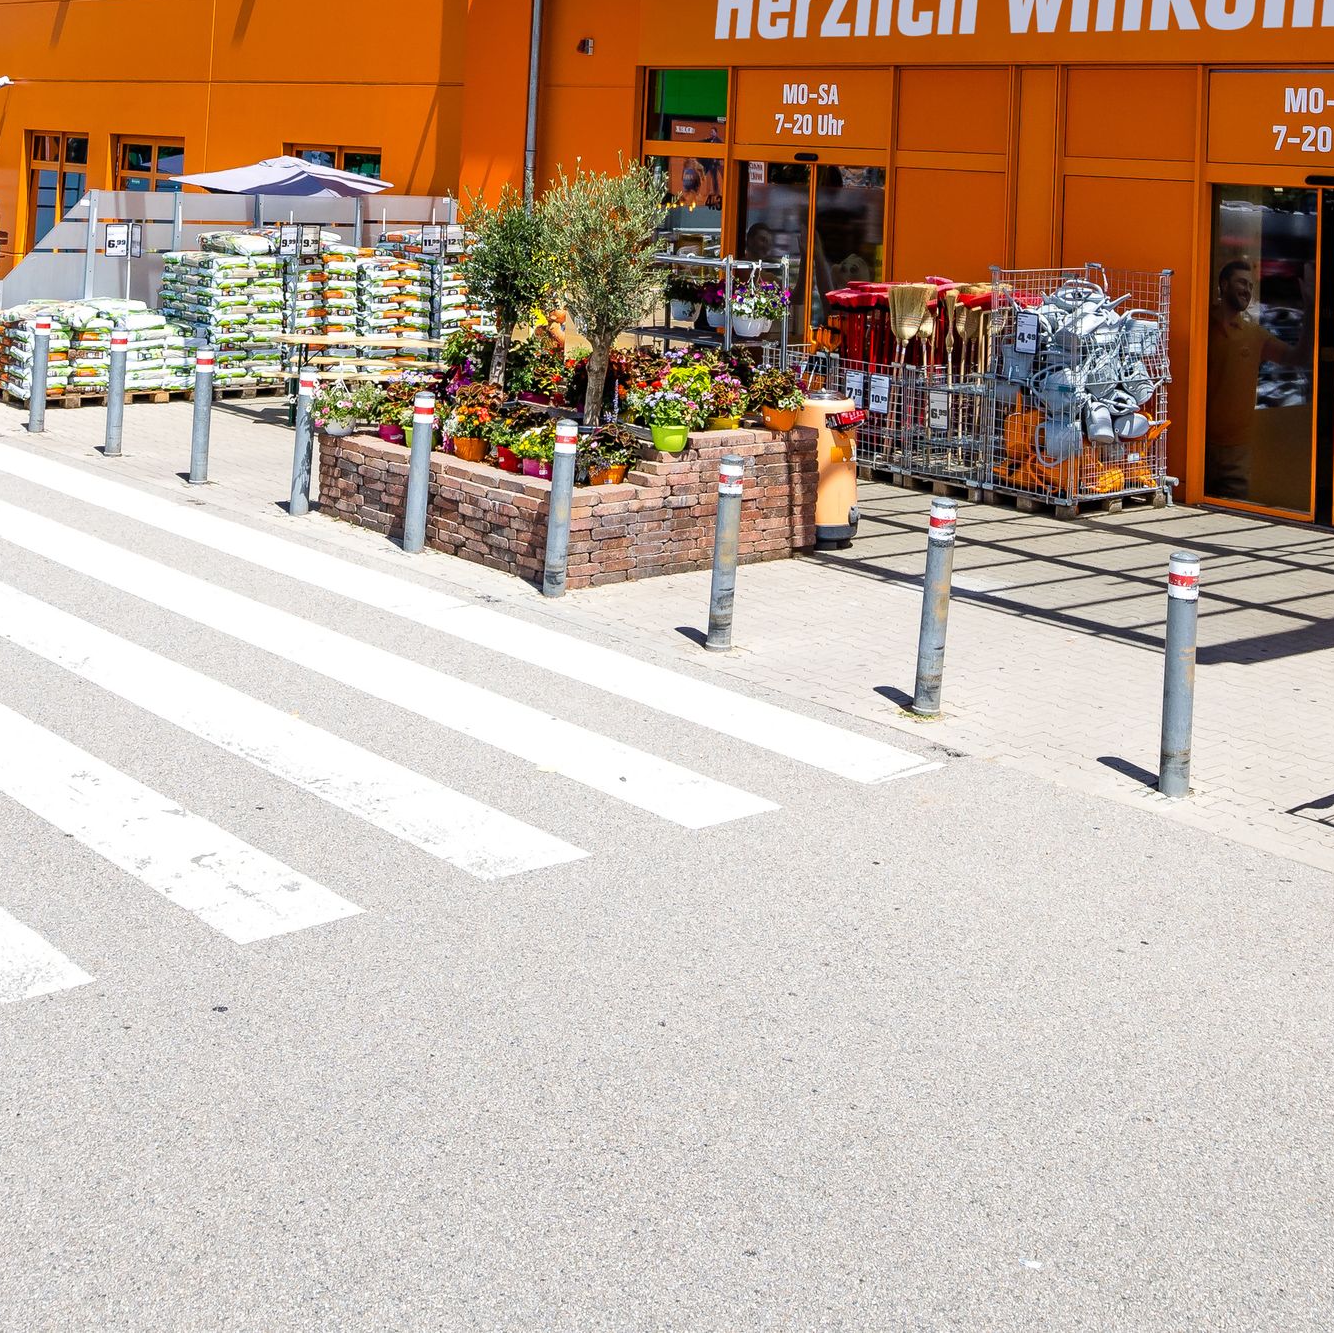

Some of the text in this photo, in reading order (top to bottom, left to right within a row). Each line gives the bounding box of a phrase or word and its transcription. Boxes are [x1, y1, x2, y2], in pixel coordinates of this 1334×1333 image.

[782, 83, 839, 105] MO-SA
[774, 113, 845, 136] 7-20 Uhr
[1272, 125, 1332, 152] 7-20
